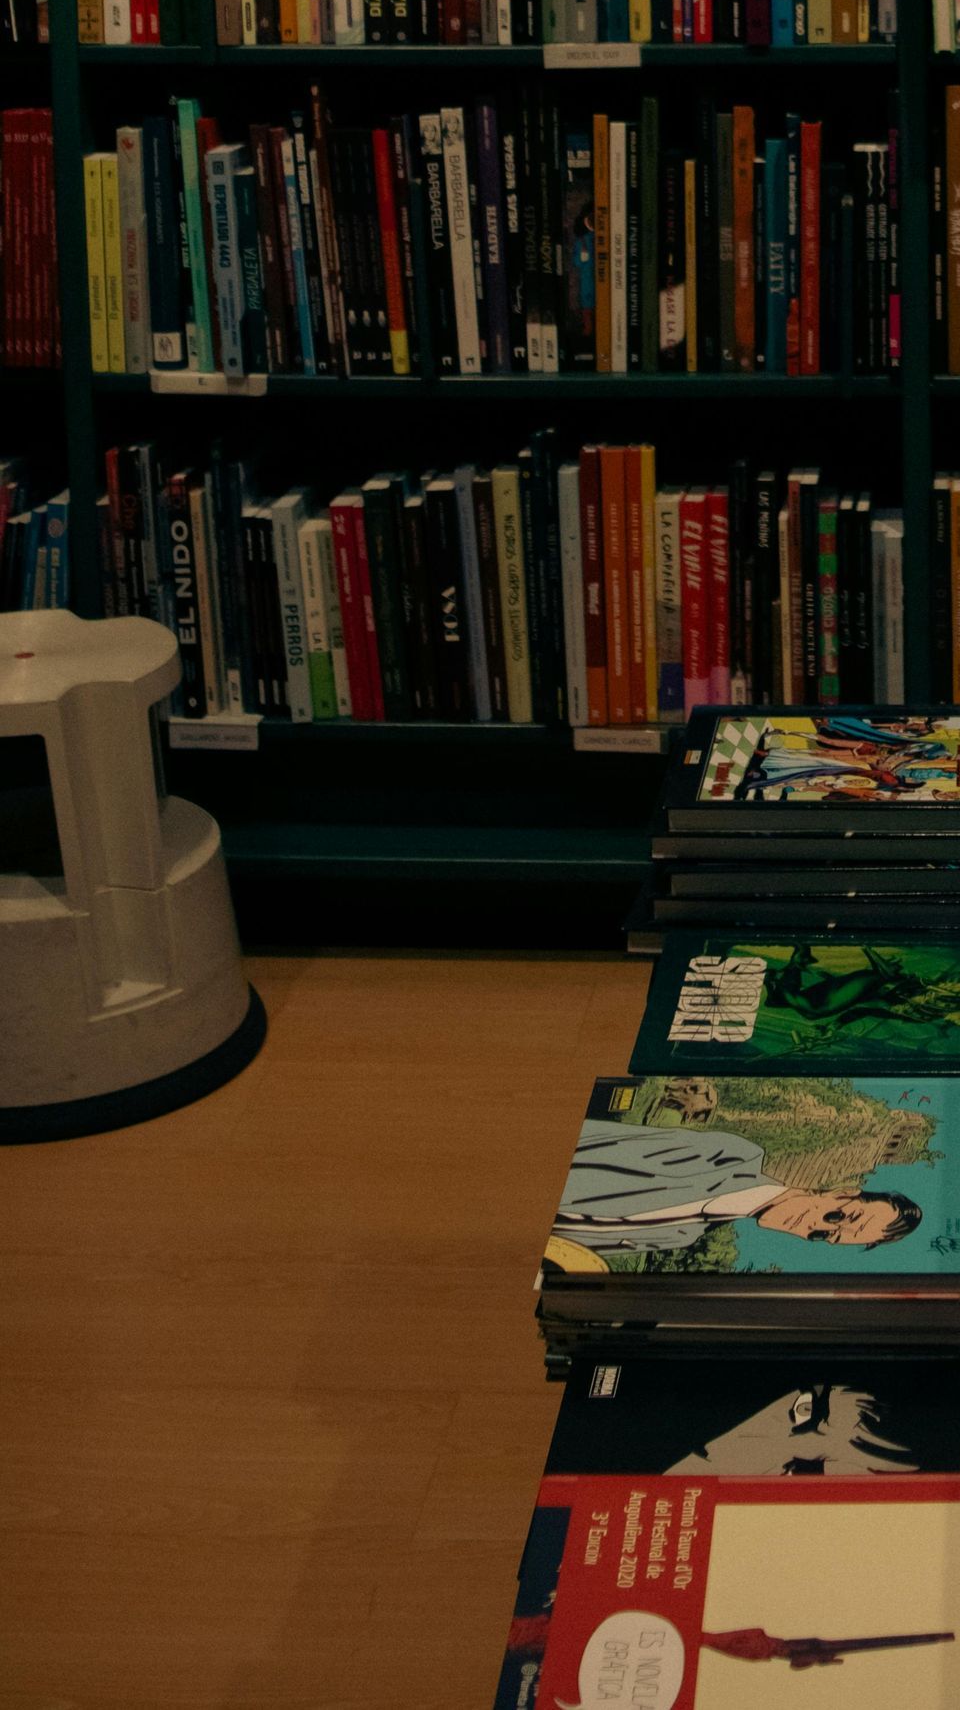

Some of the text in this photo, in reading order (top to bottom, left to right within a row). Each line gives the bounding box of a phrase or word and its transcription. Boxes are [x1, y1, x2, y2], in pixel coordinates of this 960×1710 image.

[426, 162, 445, 250] BARBARELLA
[449, 154, 466, 242] BARBARELLA
[504, 135, 518, 233] IDEAS NEGRAS
[215, 184, 231, 268] DEPORTADO 4443
[486, 205, 499, 264] KADATH
[720, 227, 732, 261] MIES
[243, 248, 262, 309] PARDALETA
[768, 241, 784, 295] FATTY
[170, 520, 196, 645] EL NIDO
[683, 520, 703, 591] EL VIAJE
[709, 514, 728, 586] EL VIAJE
[285, 603, 304, 666] PERROS
[666, 956, 768, 1043] SPIDER
[615, 1490, 647, 1589] Angoulême 2020
[645, 1499, 673, 1580] del Festival de
[671, 1488, 703, 1591] Premio Fauve d'Or
